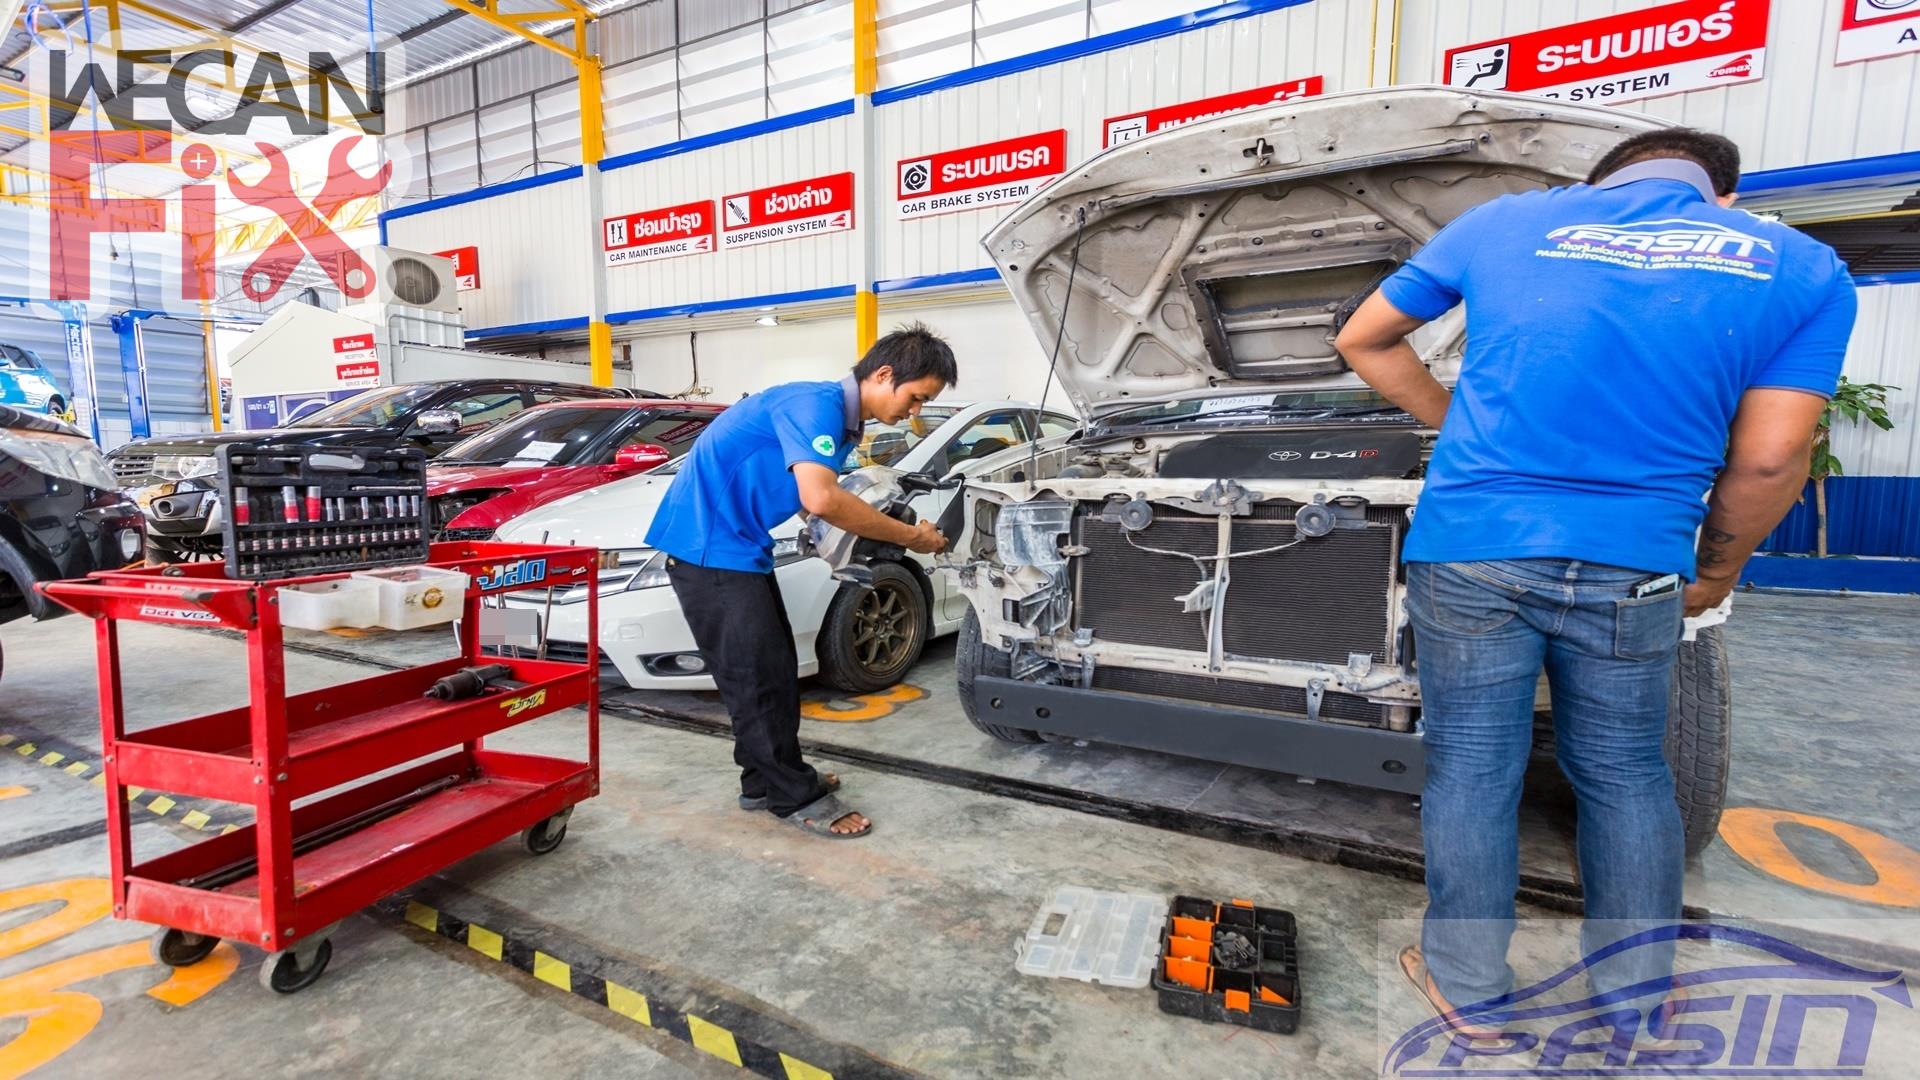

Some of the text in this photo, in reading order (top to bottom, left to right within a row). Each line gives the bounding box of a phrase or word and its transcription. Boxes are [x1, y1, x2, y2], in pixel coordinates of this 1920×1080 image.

[1536, 1, 1736, 73] ระบบแอร์
[1570, 72, 1670, 102] SYSTEM
[941, 146, 1050, 183] ระบบเบรค
[765, 185, 833, 215] ช่วงล่าง
[902, 185, 1029, 214] CAR BRAKE SYSTEM
[634, 212, 702, 239] ซ่อมบำรุง
[726, 219, 827, 245] SUSPENSION SYSTEM
[609, 243, 688, 262] CAR MAINTENANCE
[1566, 229, 1756, 257] PASIN
[1536, 250, 1570, 259] PASIN
[1645, 261, 1694, 270] LIMITED
[1695, 262, 1773, 281] PARTNERSHIP
